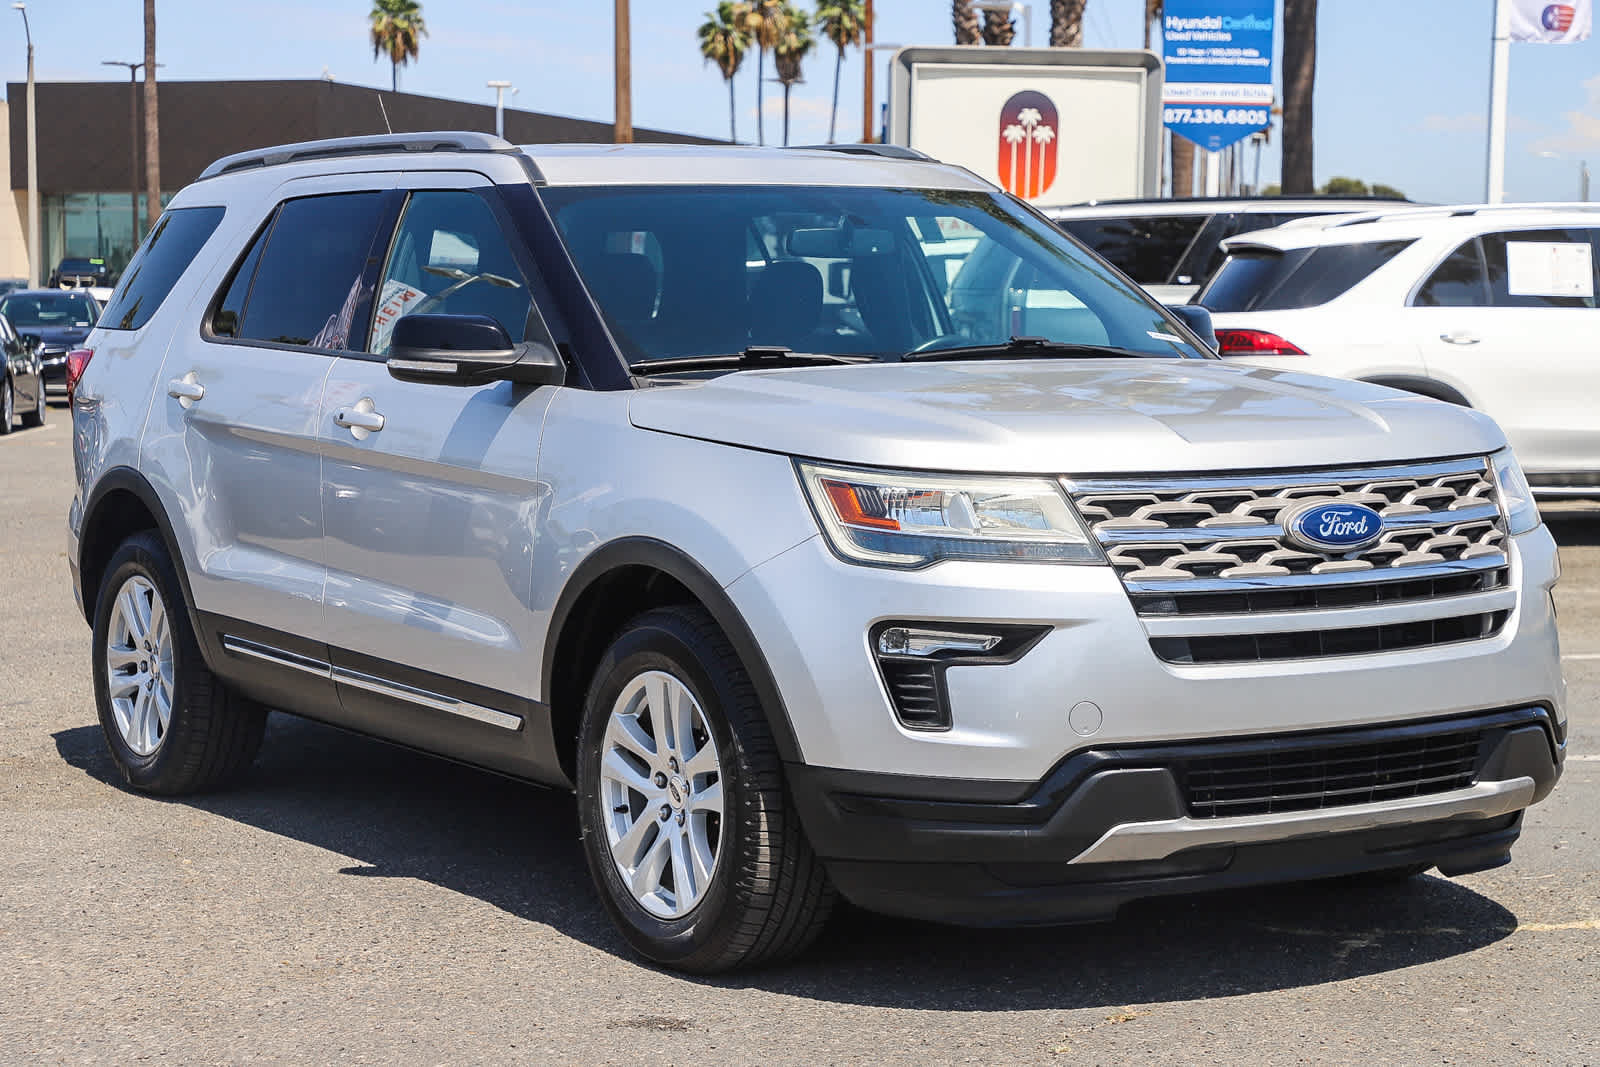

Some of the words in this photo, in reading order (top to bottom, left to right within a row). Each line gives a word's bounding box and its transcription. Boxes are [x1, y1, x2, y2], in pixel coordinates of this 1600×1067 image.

[1165, 16, 1222, 31] Hyundai
[1222, 14, 1272, 31] Certified
[1319, 510, 1368, 537] Ford
